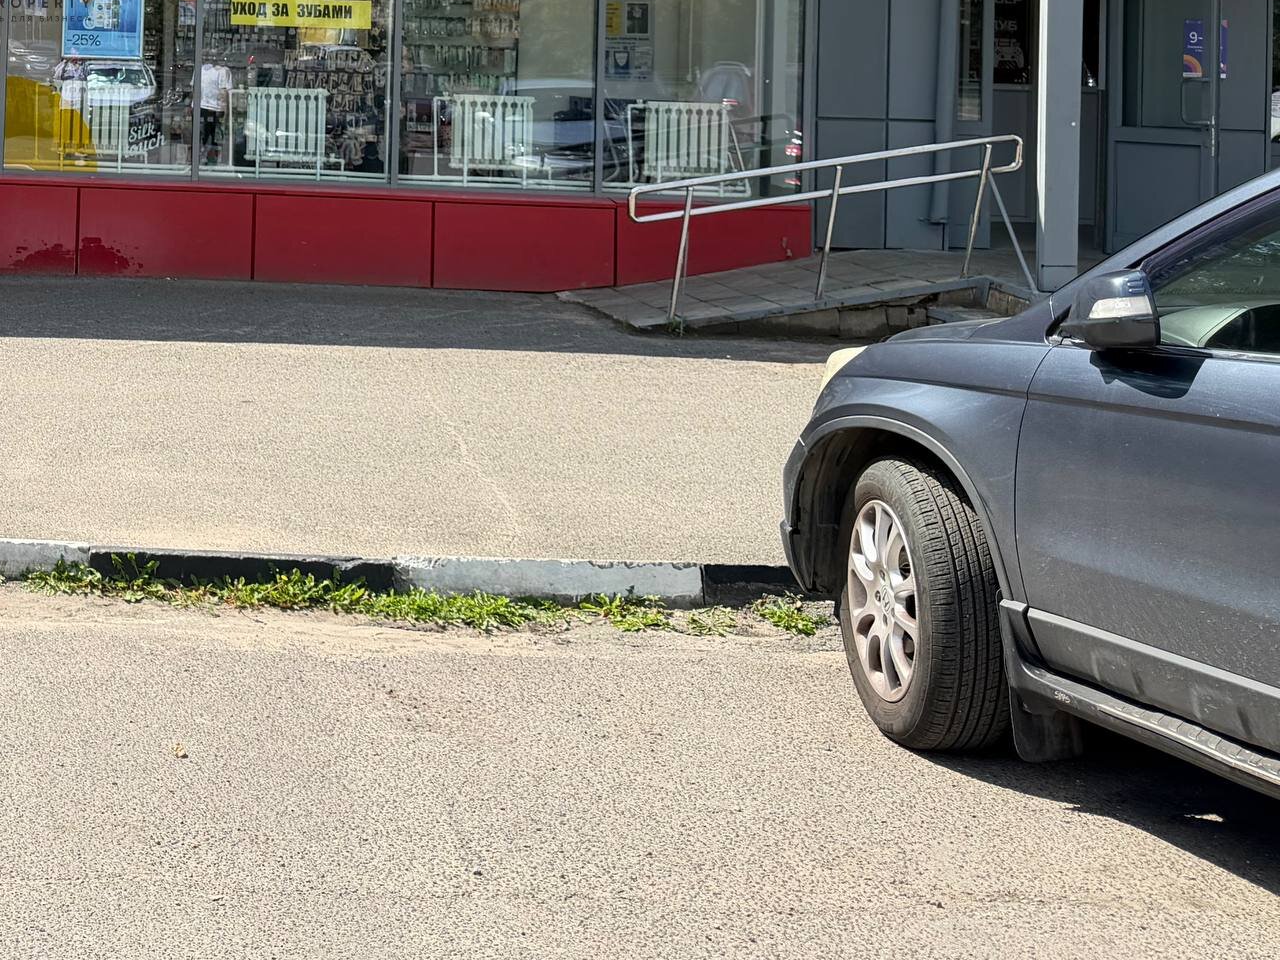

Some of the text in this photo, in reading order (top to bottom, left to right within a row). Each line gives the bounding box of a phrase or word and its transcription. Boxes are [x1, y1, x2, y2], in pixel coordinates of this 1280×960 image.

[231, 1, 353, 19] УХОД ЗА ЗУБАМИ
[66, 33, 101, 46] -25%
